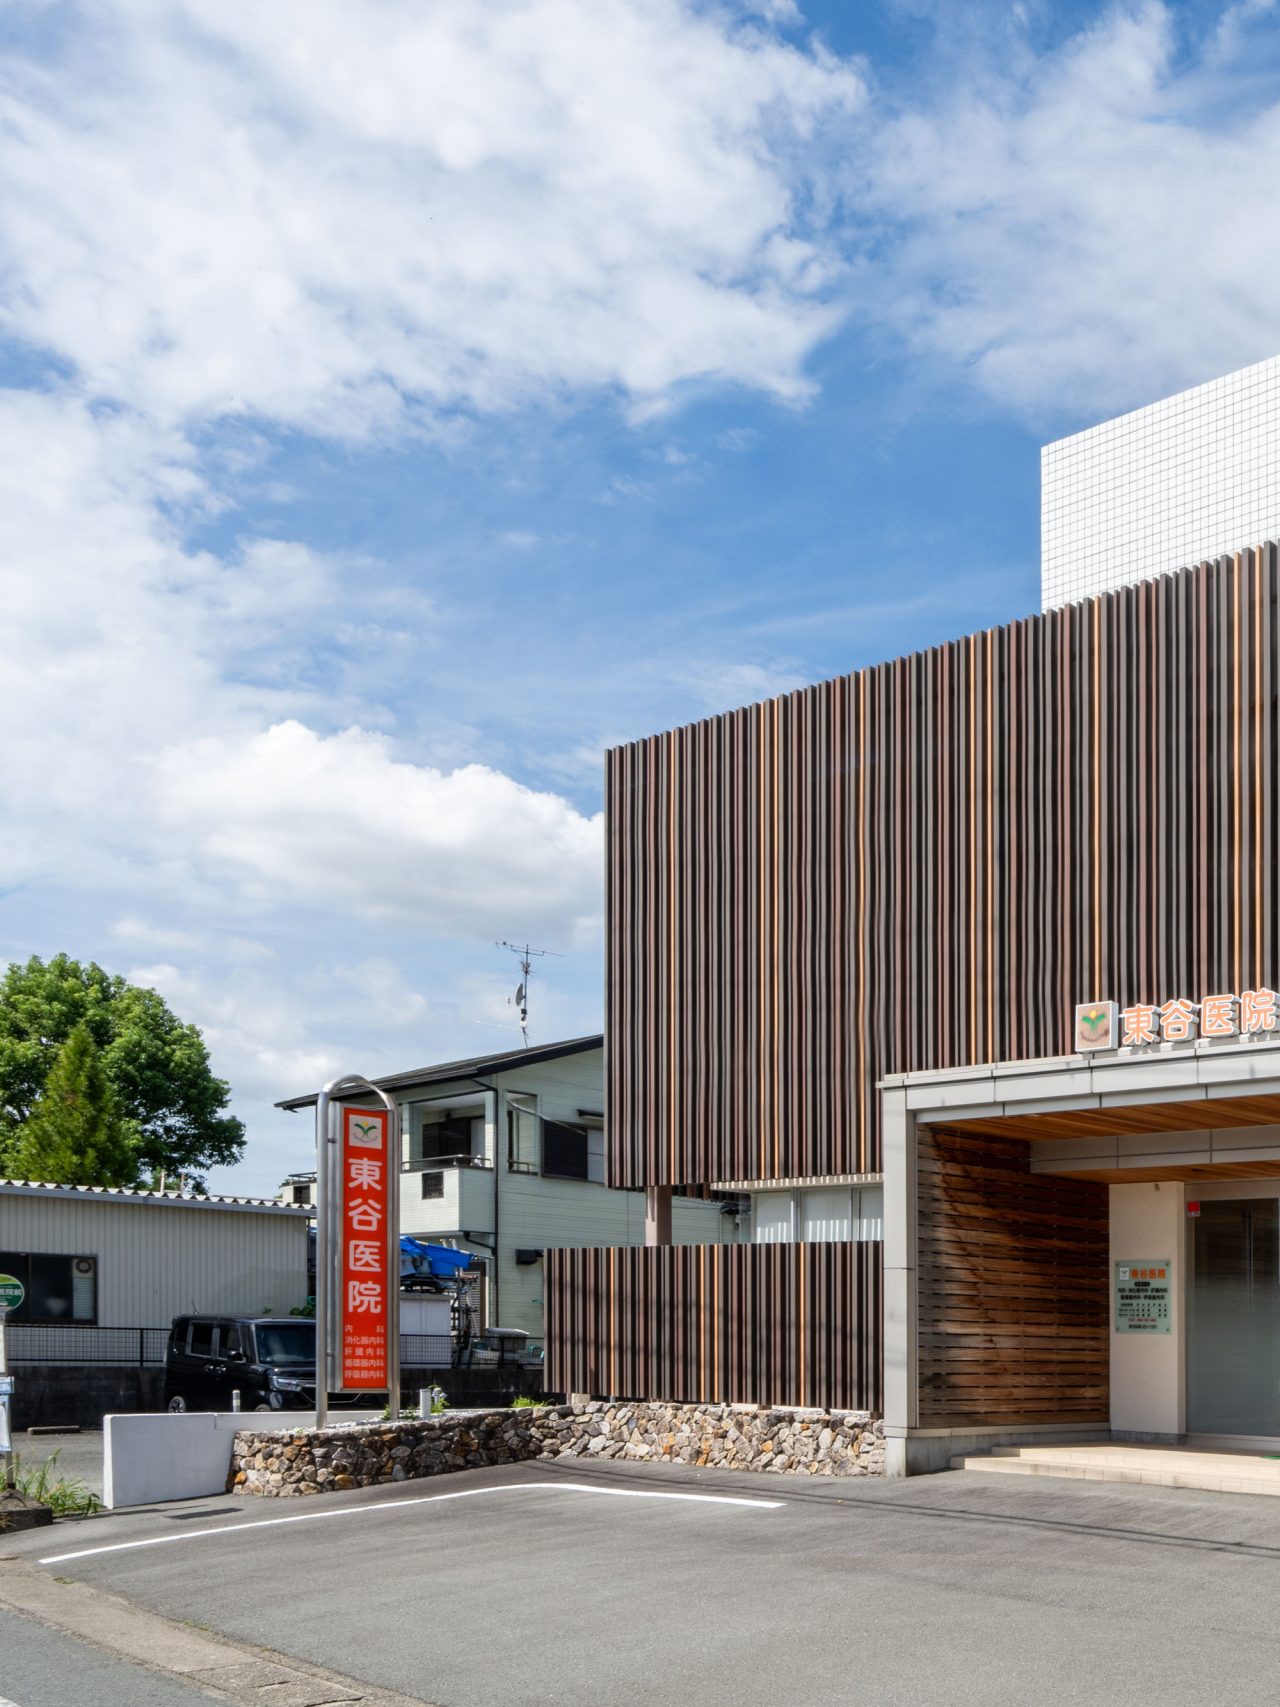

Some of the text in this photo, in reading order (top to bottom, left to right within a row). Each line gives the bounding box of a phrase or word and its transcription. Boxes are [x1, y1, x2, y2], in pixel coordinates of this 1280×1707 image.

[1122, 987, 1277, 1046] 東谷医院
[347, 1157, 383, 1314] 東谷医院
